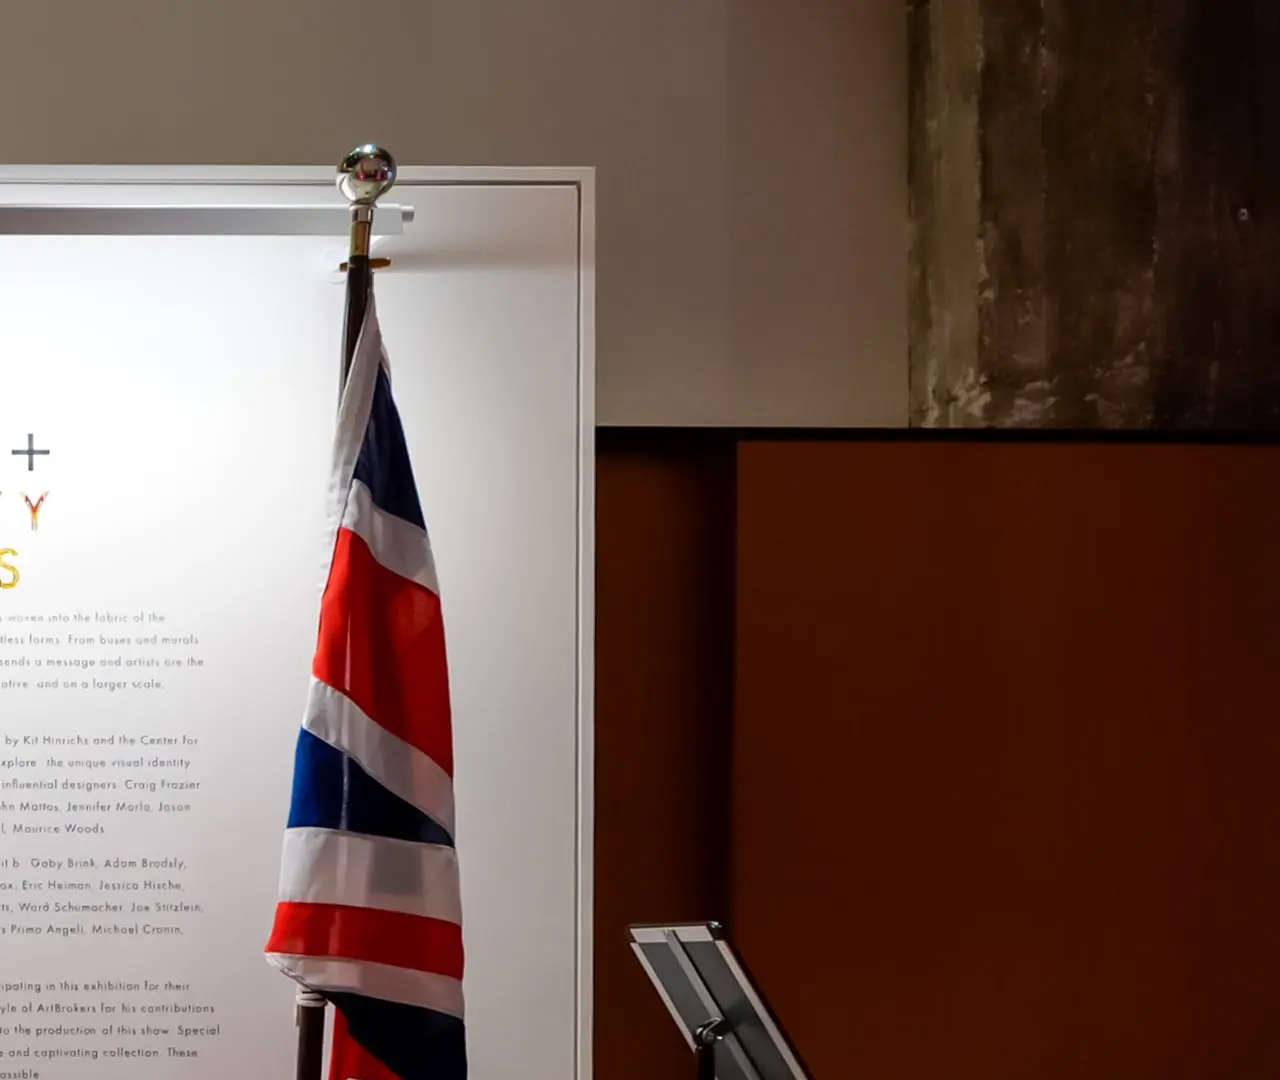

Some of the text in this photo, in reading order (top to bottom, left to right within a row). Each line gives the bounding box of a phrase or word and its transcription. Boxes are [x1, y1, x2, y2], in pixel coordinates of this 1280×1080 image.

[68, 632, 96, 645] From
[100, 632, 132, 645] buses
[135, 632, 158, 645] and
[161, 632, 200, 645] murals
[0, 654, 31, 667] sends
[46, 659, 96, 670] message
[100, 654, 122, 667] and
[125, 656, 161, 667] artists
[187, 654, 205, 667] the
[36, 676, 60, 689] and
[92, 676, 128, 692] larger
[23, 733, 39, 746] Kit
[43, 733, 89, 746] Hinrichs
[92, 733, 115, 746] and
[118, 733, 137, 746] the
[140, 733, 178, 746] Center
[182, 733, 199, 746] for
[46, 756, 64, 768] the
[68, 756, 106, 770] unique
[111, 756, 144, 768] visual
[148, 756, 191, 770] identity
[2, 778, 58, 790] influential
[124, 778, 157, 792] Craig
[66, 800, 112, 812] Jennifer
[158, 800, 192, 812] Jason
[13, 822, 60, 834] Maurice
[104, 856, 138, 868] Adam
[22, 878, 43, 890] Eric
[99, 878, 140, 890] Jessica
[19, 900, 50, 912] Ward
[131, 900, 151, 912] Joe
[10, 922, 43, 935] Primo
[92, 922, 139, 935] Michael
[60, 979, 79, 992] this
[84, 979, 140, 992] exhibition
[144, 979, 160, 992] for
[164, 979, 190, 992] their
[36, 1001, 97, 1014] ArtBrokers
[100, 1001, 116, 1014] for
[121, 1001, 137, 1014] his
[140, 1001, 216, 1014] contributions
[14, 1023, 32, 1036] the
[36, 1023, 97, 1038] production
[117, 1023, 137, 1036] this
[178, 1023, 221, 1038] Special
[8, 1045, 31, 1058] and
[34, 1046, 99, 1060] captivating
[168, 1045, 198, 1058] These
